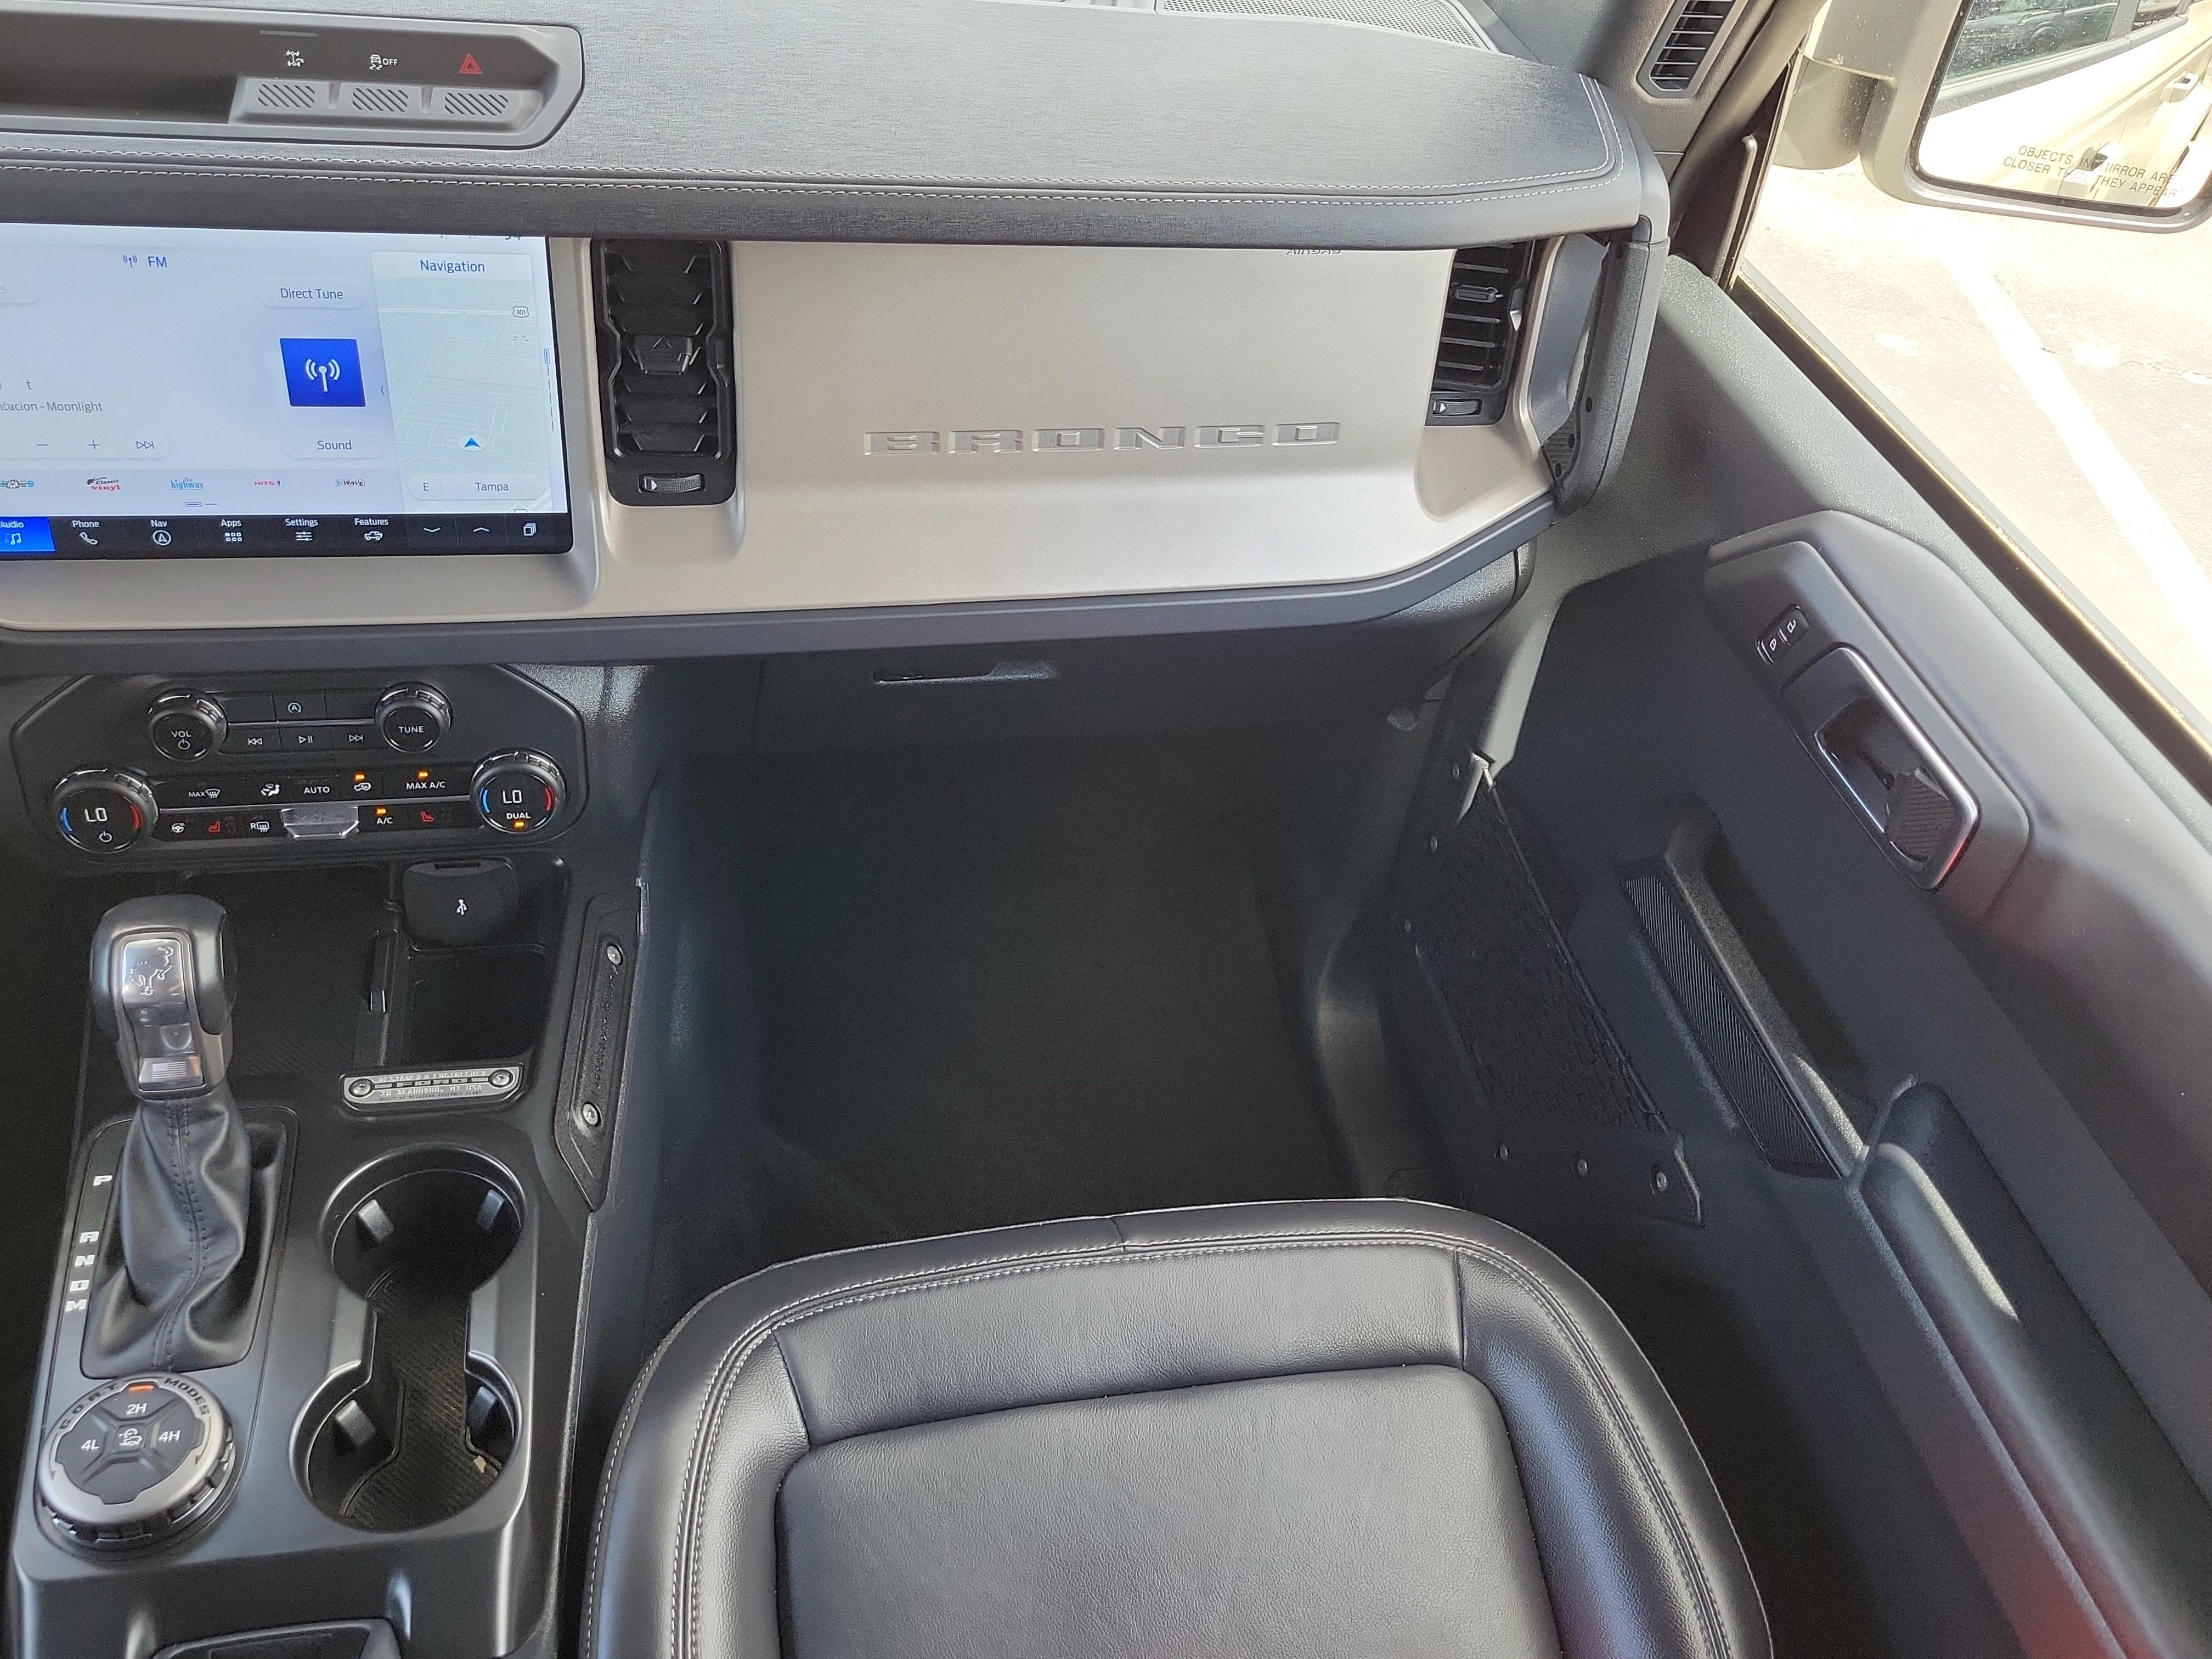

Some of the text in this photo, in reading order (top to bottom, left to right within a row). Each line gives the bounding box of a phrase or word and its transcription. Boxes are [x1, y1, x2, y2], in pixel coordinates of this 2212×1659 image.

[382, 58, 398, 66] OFF
[2018, 145, 2073, 165] OBJECTS
[2079, 157, 2093, 168] IN
[2004, 157, 2051, 174] CLOSER
[2095, 175, 2127, 189] THEY
[2129, 182, 2177, 198] APPEAR
[148, 256, 168, 268] FM
[420, 259, 486, 274] Navigation
[280, 287, 343, 300] Direct Tune
[47, 401, 103, 413] Moonlight
[863, 422, 1340, 455] BRONCO
[317, 440, 352, 450] Sound
[170, 479, 204, 489] highway
[422, 482, 430, 491] E
[475, 482, 509, 493] Tampa
[72, 520, 100, 528] Phone
[150, 520, 168, 528] Nav
[221, 518, 242, 528] Apps
[285, 518, 319, 527] Settings
[354, 517, 389, 526] Features
[171, 730, 192, 738] VOL
[398, 725, 425, 733] TUNE
[303, 786, 330, 795] AUTO
[429, 781, 447, 789] A/C
[503, 789, 522, 804] LO
[84, 807, 108, 823] LO
[376, 816, 393, 825] A/C
[93, 1175, 112, 1187] P
[75, 1254, 95, 1267] N
[65, 1299, 88, 1312] M
[164, 1378, 210, 1415] MODES
[126, 1402, 148, 1415] 2H
[158, 1430, 181, 1442] 4H
[81, 1438, 100, 1451] 4L
